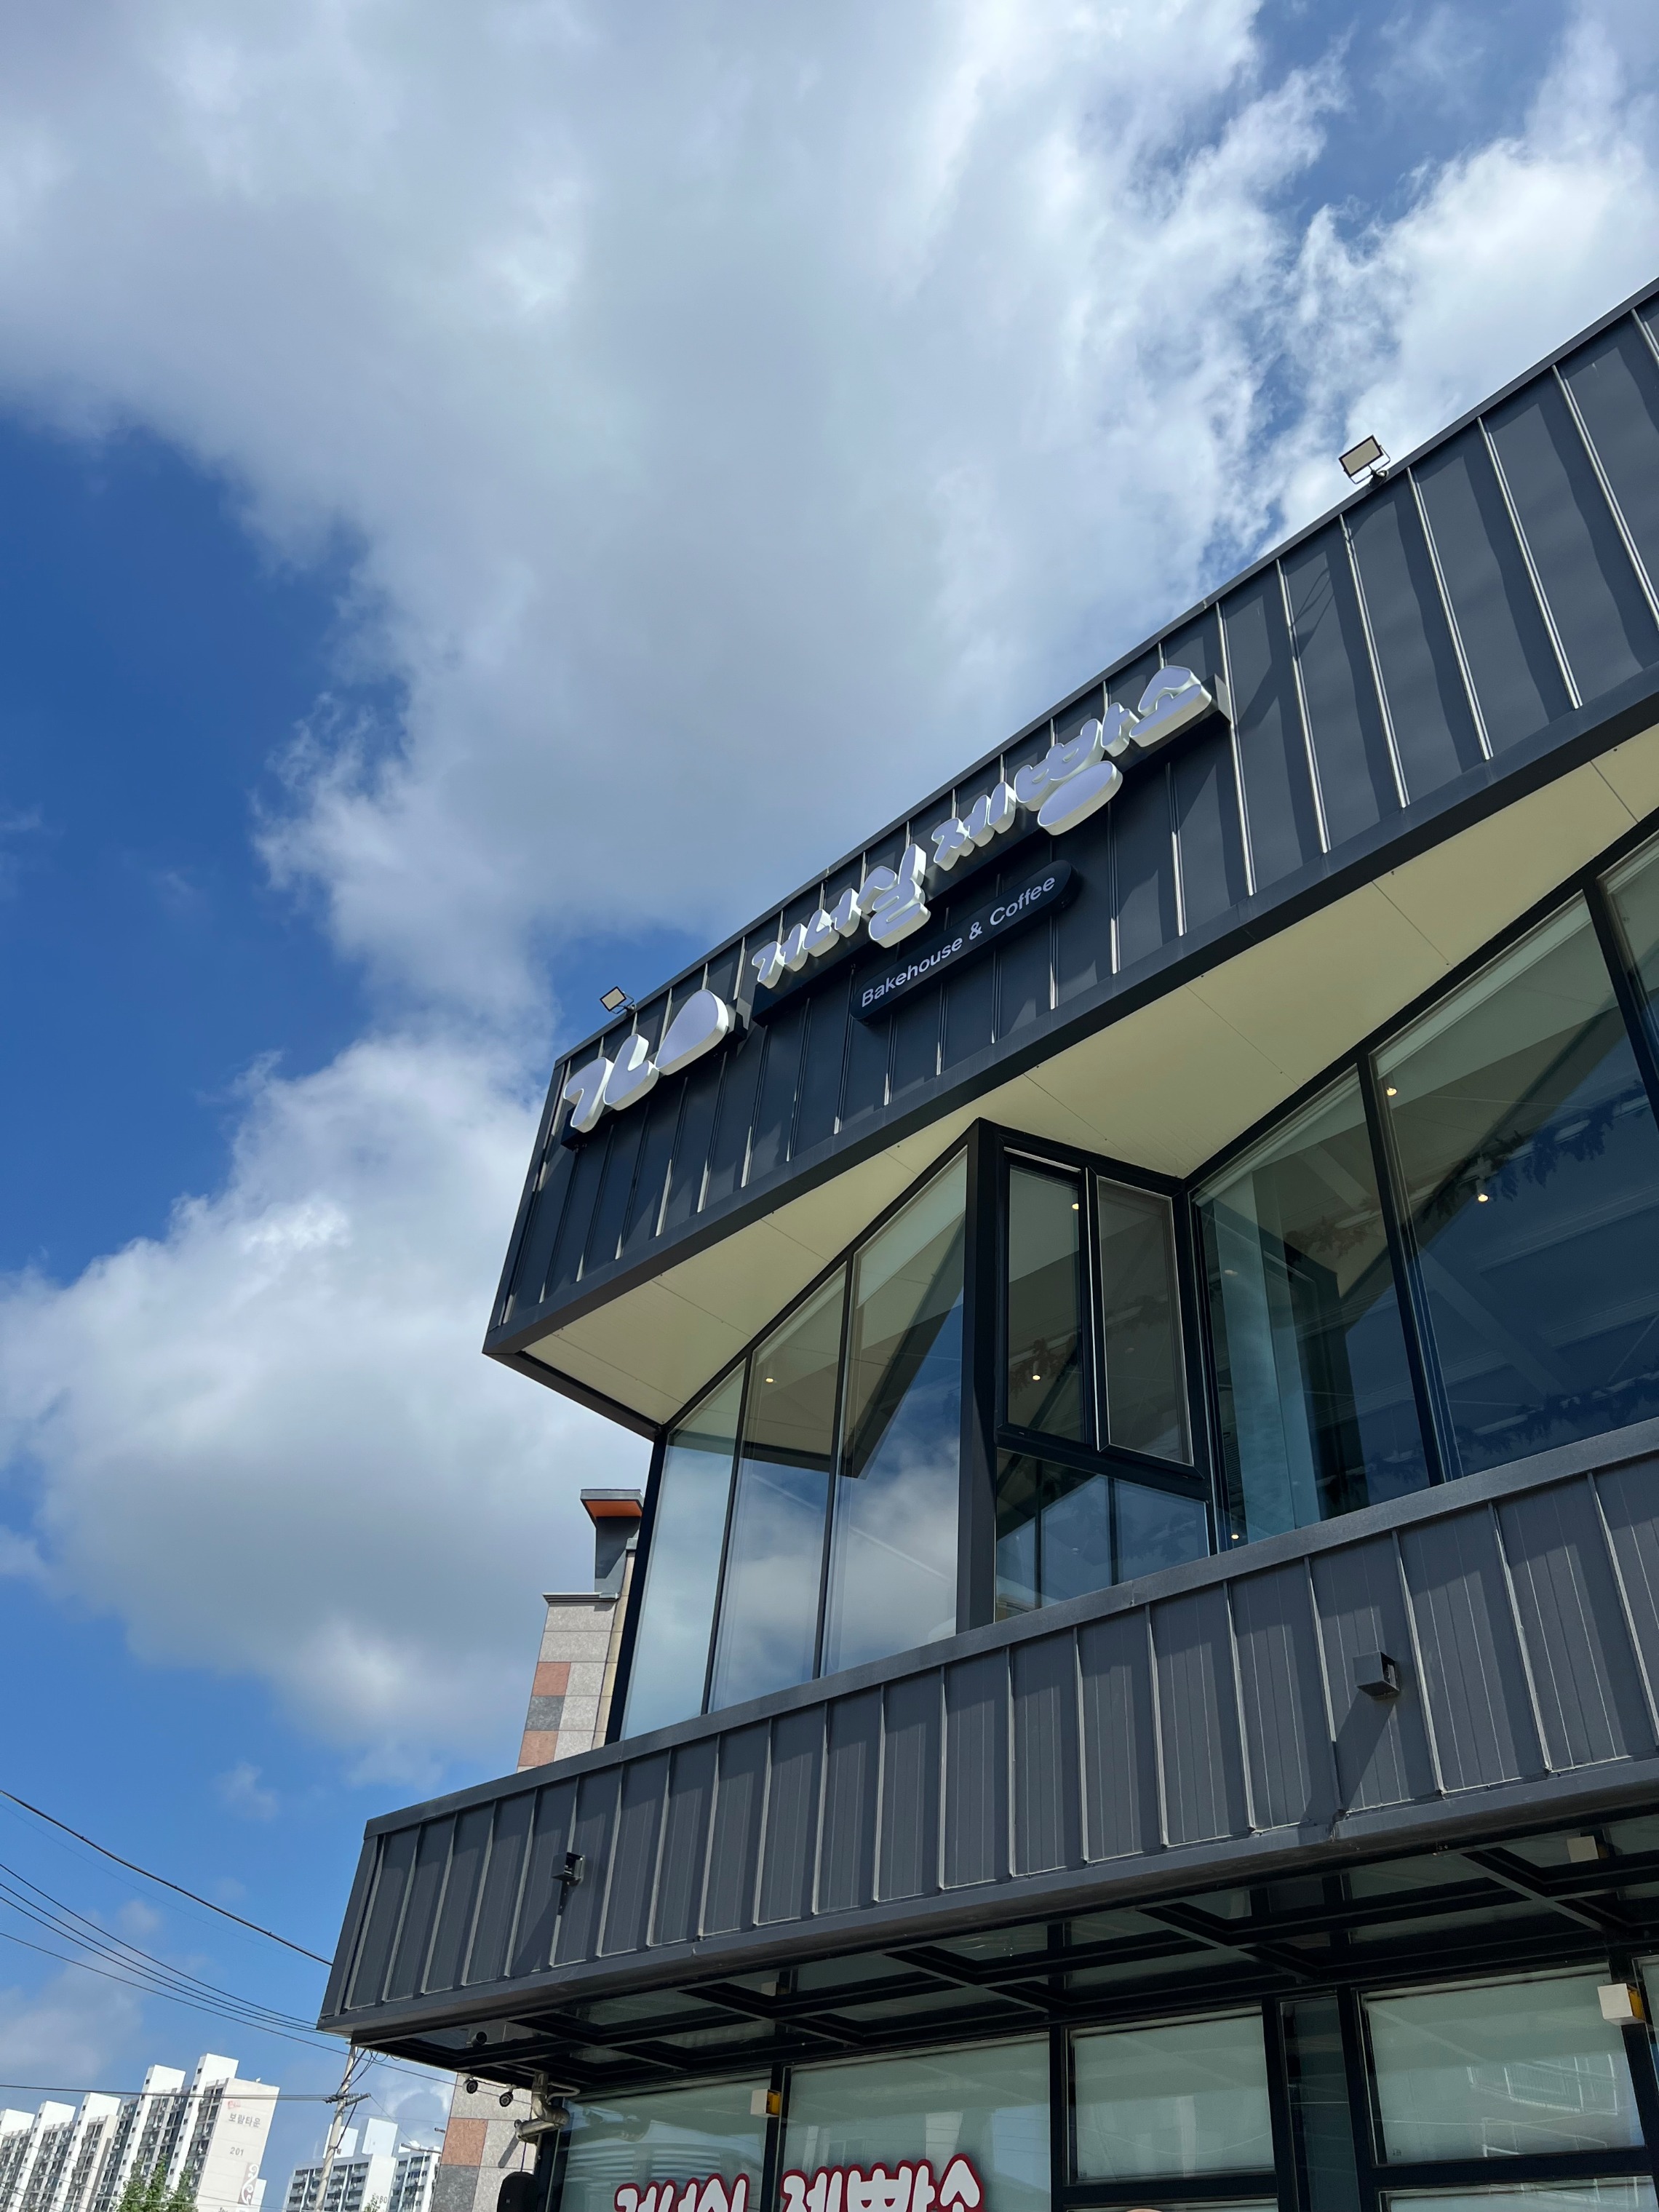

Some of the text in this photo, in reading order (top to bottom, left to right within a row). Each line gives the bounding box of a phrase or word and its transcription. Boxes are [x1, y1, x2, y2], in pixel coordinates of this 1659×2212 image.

[752, 665, 1212, 988] 거너실 제빵소
[862, 877, 1055, 1007] Bakehouse & Coffee
[228, 2113, 260, 2128] 보람타운
[230, 2147, 244, 2156] 201
